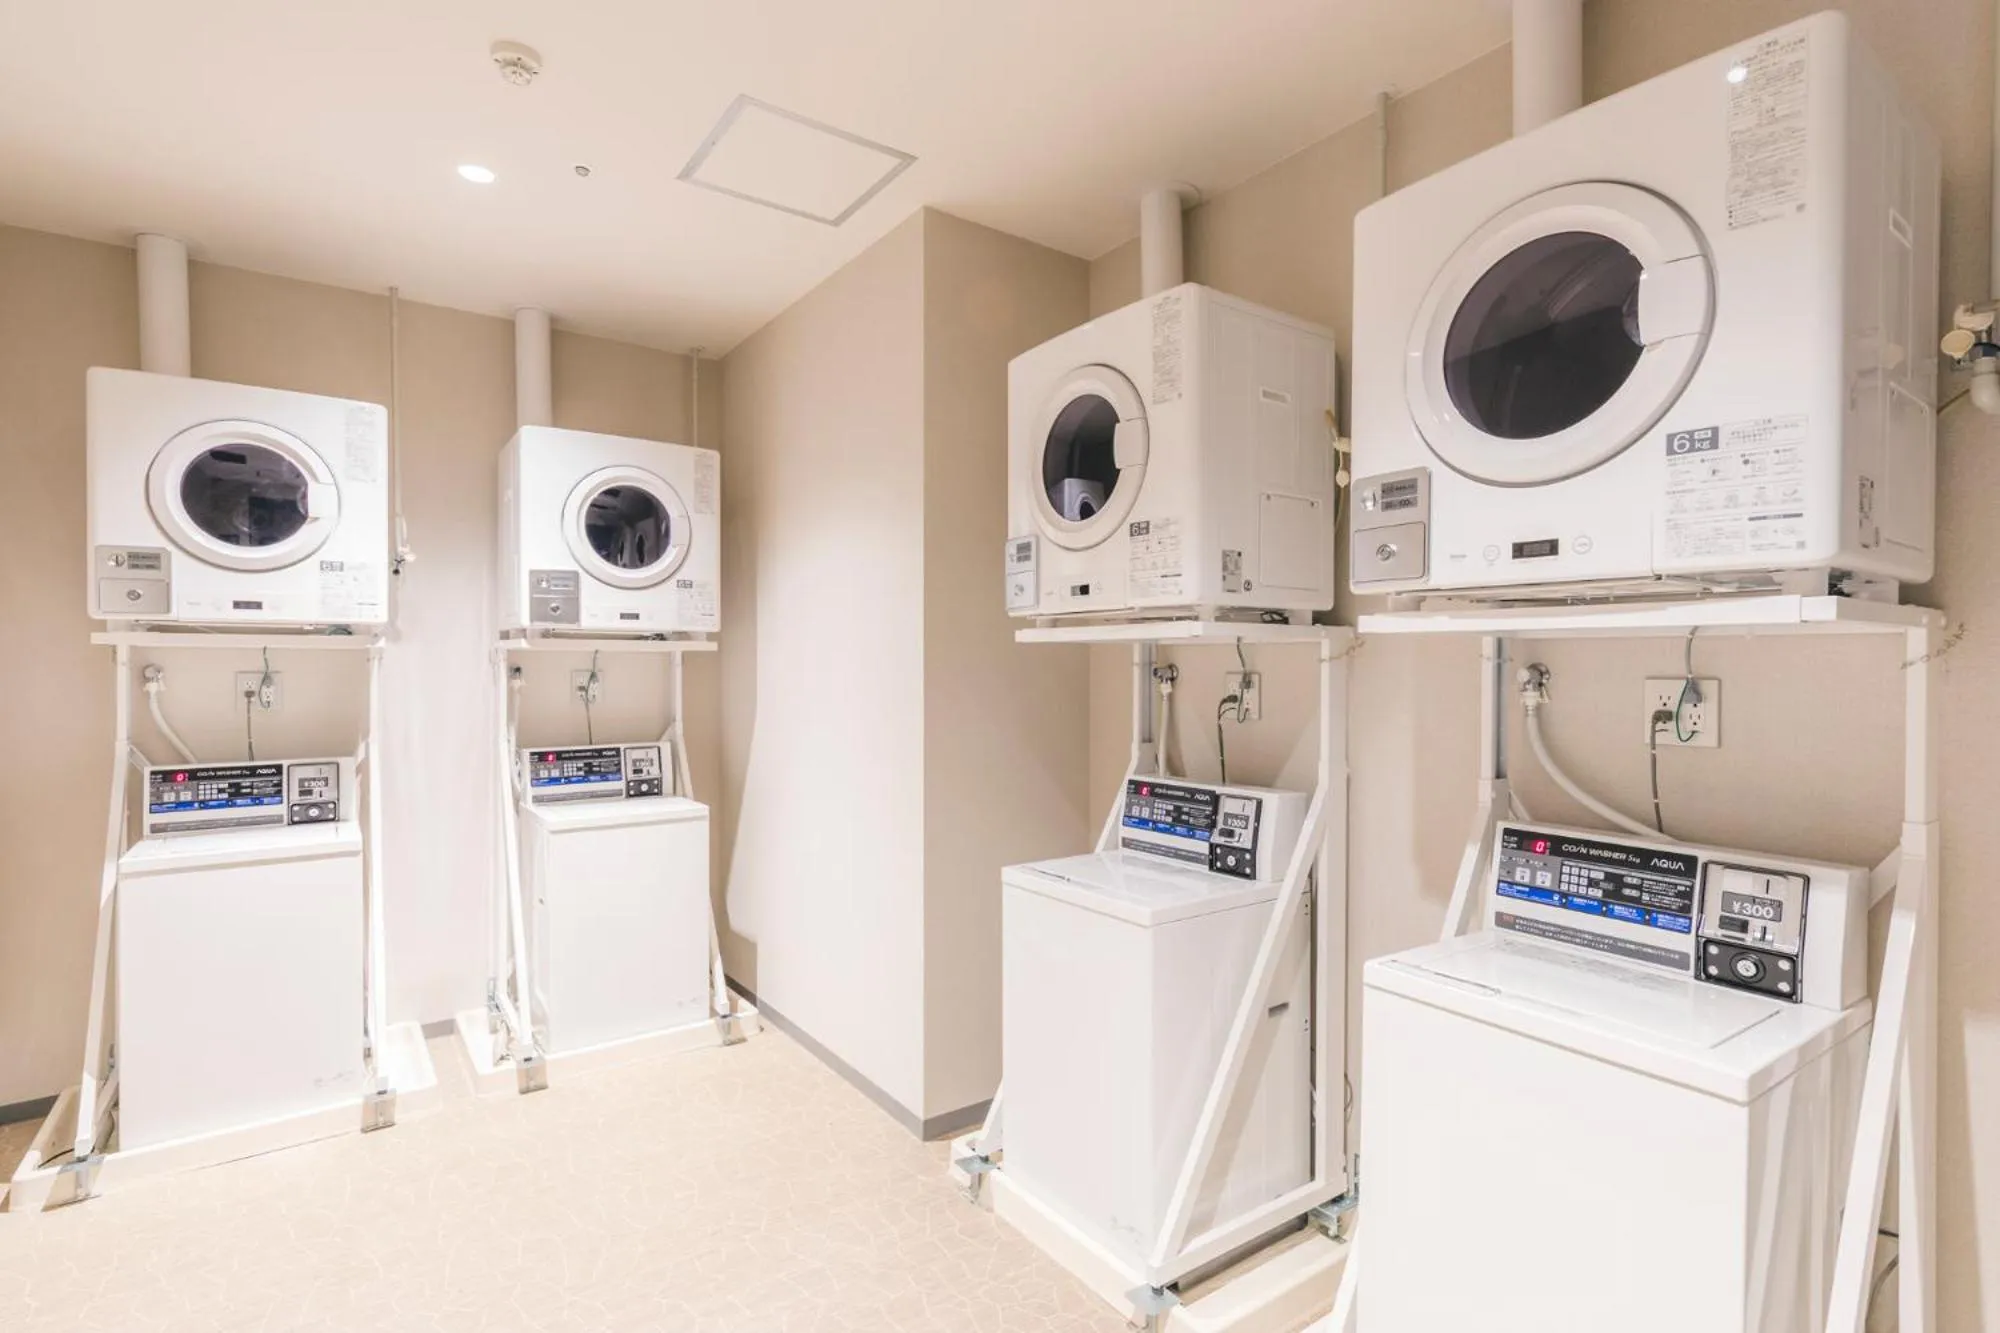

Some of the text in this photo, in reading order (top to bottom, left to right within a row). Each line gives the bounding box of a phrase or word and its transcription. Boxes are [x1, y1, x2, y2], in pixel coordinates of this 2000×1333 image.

[1673, 433, 1690, 453] 6
[1535, 841, 1545, 853] 0
[1561, 843, 1587, 855] COIN
[1589, 847, 1627, 860] WASHER
[1650, 857, 1685, 872] AQUA
[1732, 900, 1774, 919] ¥300
